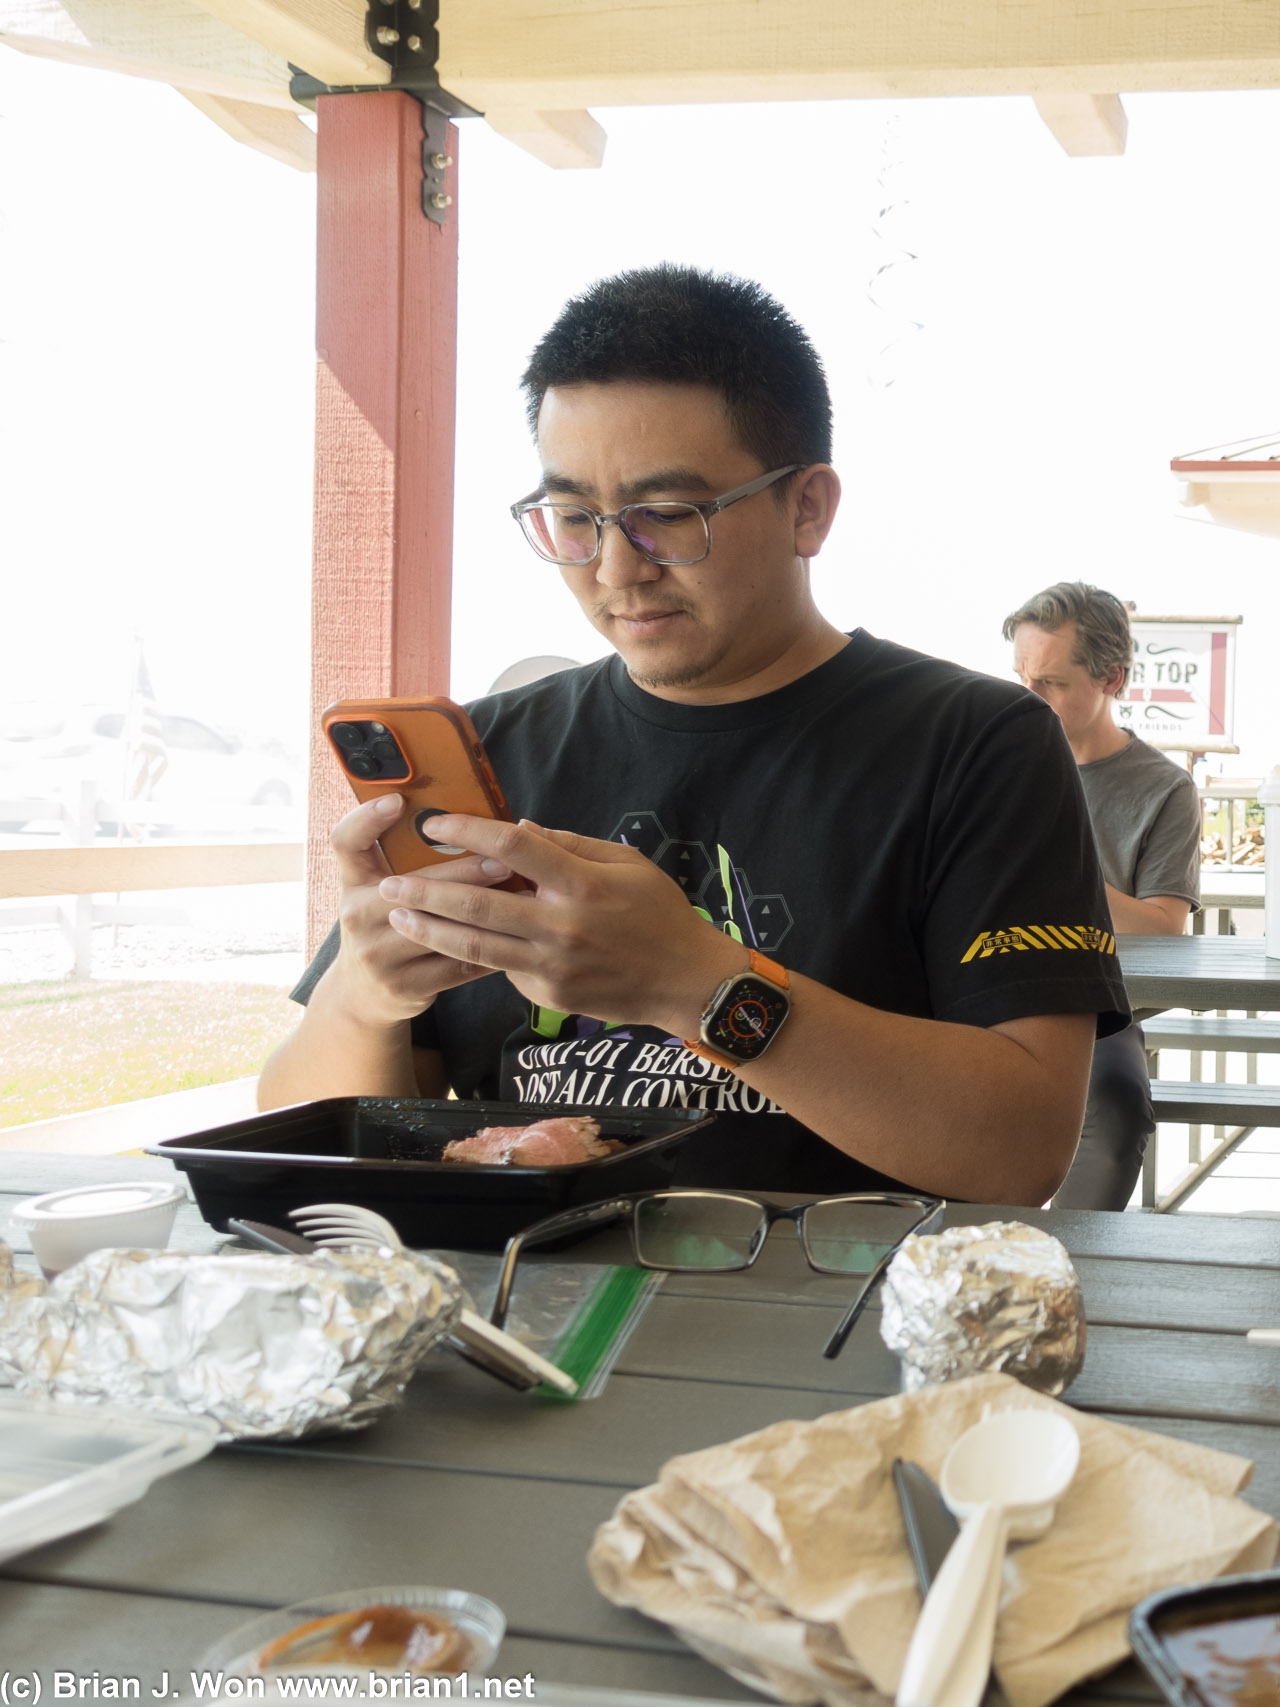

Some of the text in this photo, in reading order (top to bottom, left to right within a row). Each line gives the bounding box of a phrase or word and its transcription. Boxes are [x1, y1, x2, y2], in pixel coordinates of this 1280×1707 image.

[1154, 661, 1197, 683] TOP
[518, 1039, 630, 1070] UNIT-01
[513, 1070, 562, 1104] LOST
[554, 1069, 616, 1106] ALL
